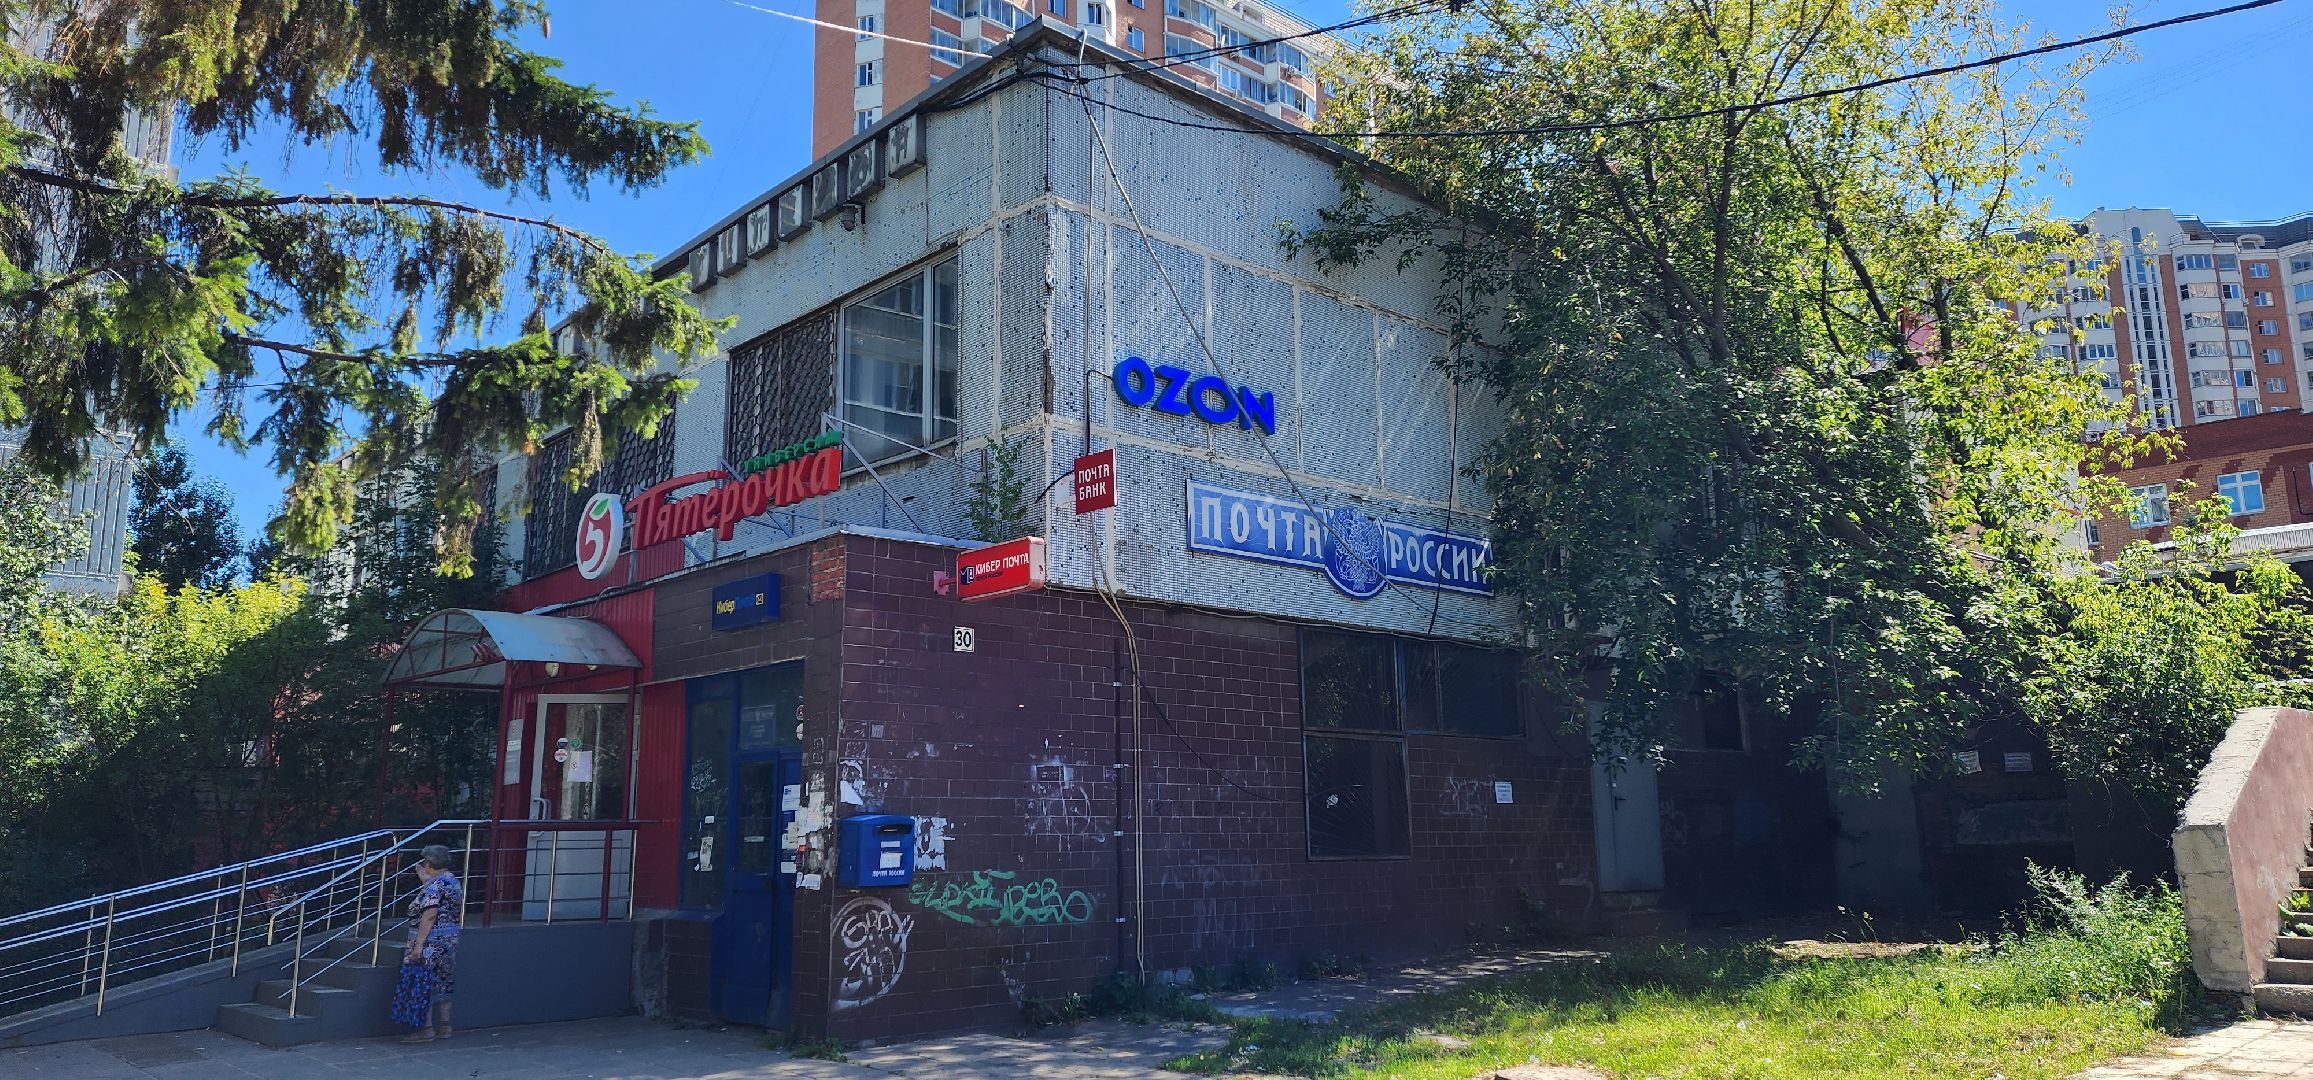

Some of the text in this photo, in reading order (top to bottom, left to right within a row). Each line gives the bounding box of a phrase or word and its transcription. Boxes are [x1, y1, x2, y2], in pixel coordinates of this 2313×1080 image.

[1112, 356, 1276, 436] OZON
[1078, 463, 1110, 484] ПОЧТА
[1079, 481, 1107, 501] БАНК
[1201, 496, 1489, 585] ПОЧТА РОССИИ
[975, 552, 1030, 576] КИБЕР ПОЧТА
[955, 629, 972, 648] 30
